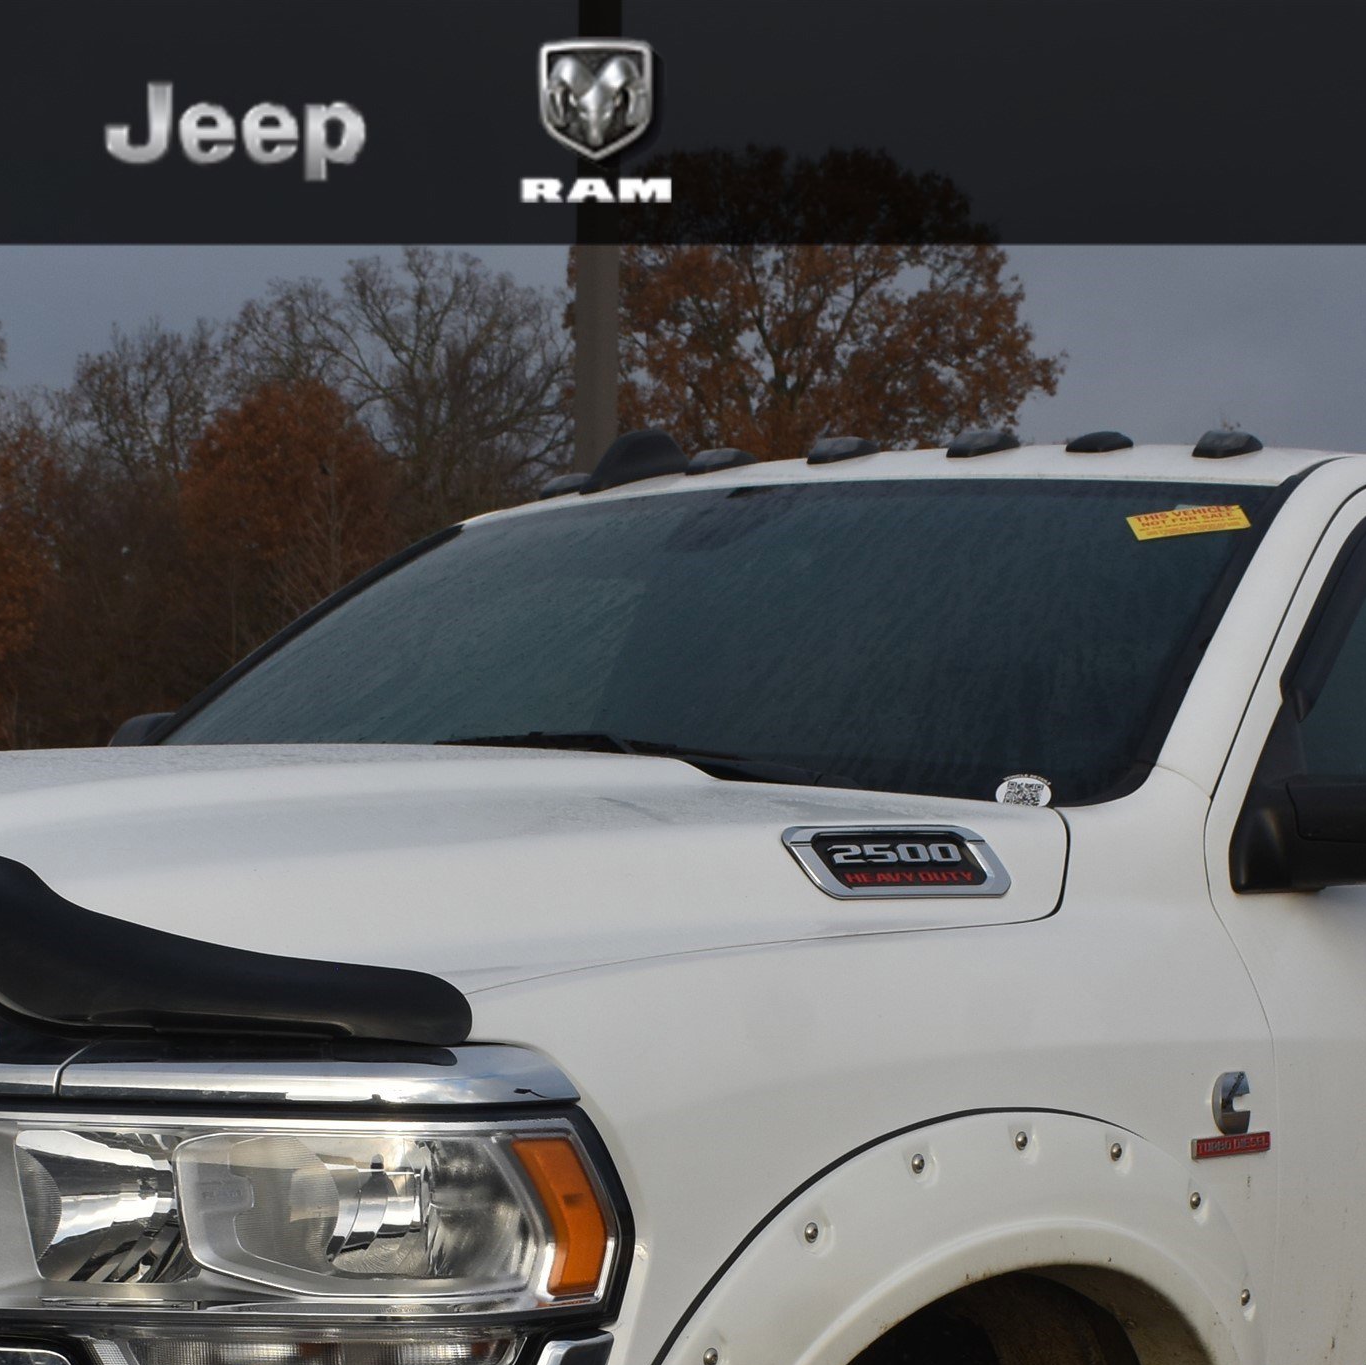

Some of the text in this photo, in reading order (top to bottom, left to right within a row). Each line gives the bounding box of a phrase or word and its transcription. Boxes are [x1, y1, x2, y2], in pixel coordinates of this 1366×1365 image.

[1135, 505, 1237, 523] THIS VEHICLE
[1140, 520, 1169, 528] NOT
[1171, 516, 1198, 525] FOR
[1200, 511, 1238, 520] SALE
[827, 843, 962, 866] 2500
[843, 872, 975, 884] HEAVY DUTY
